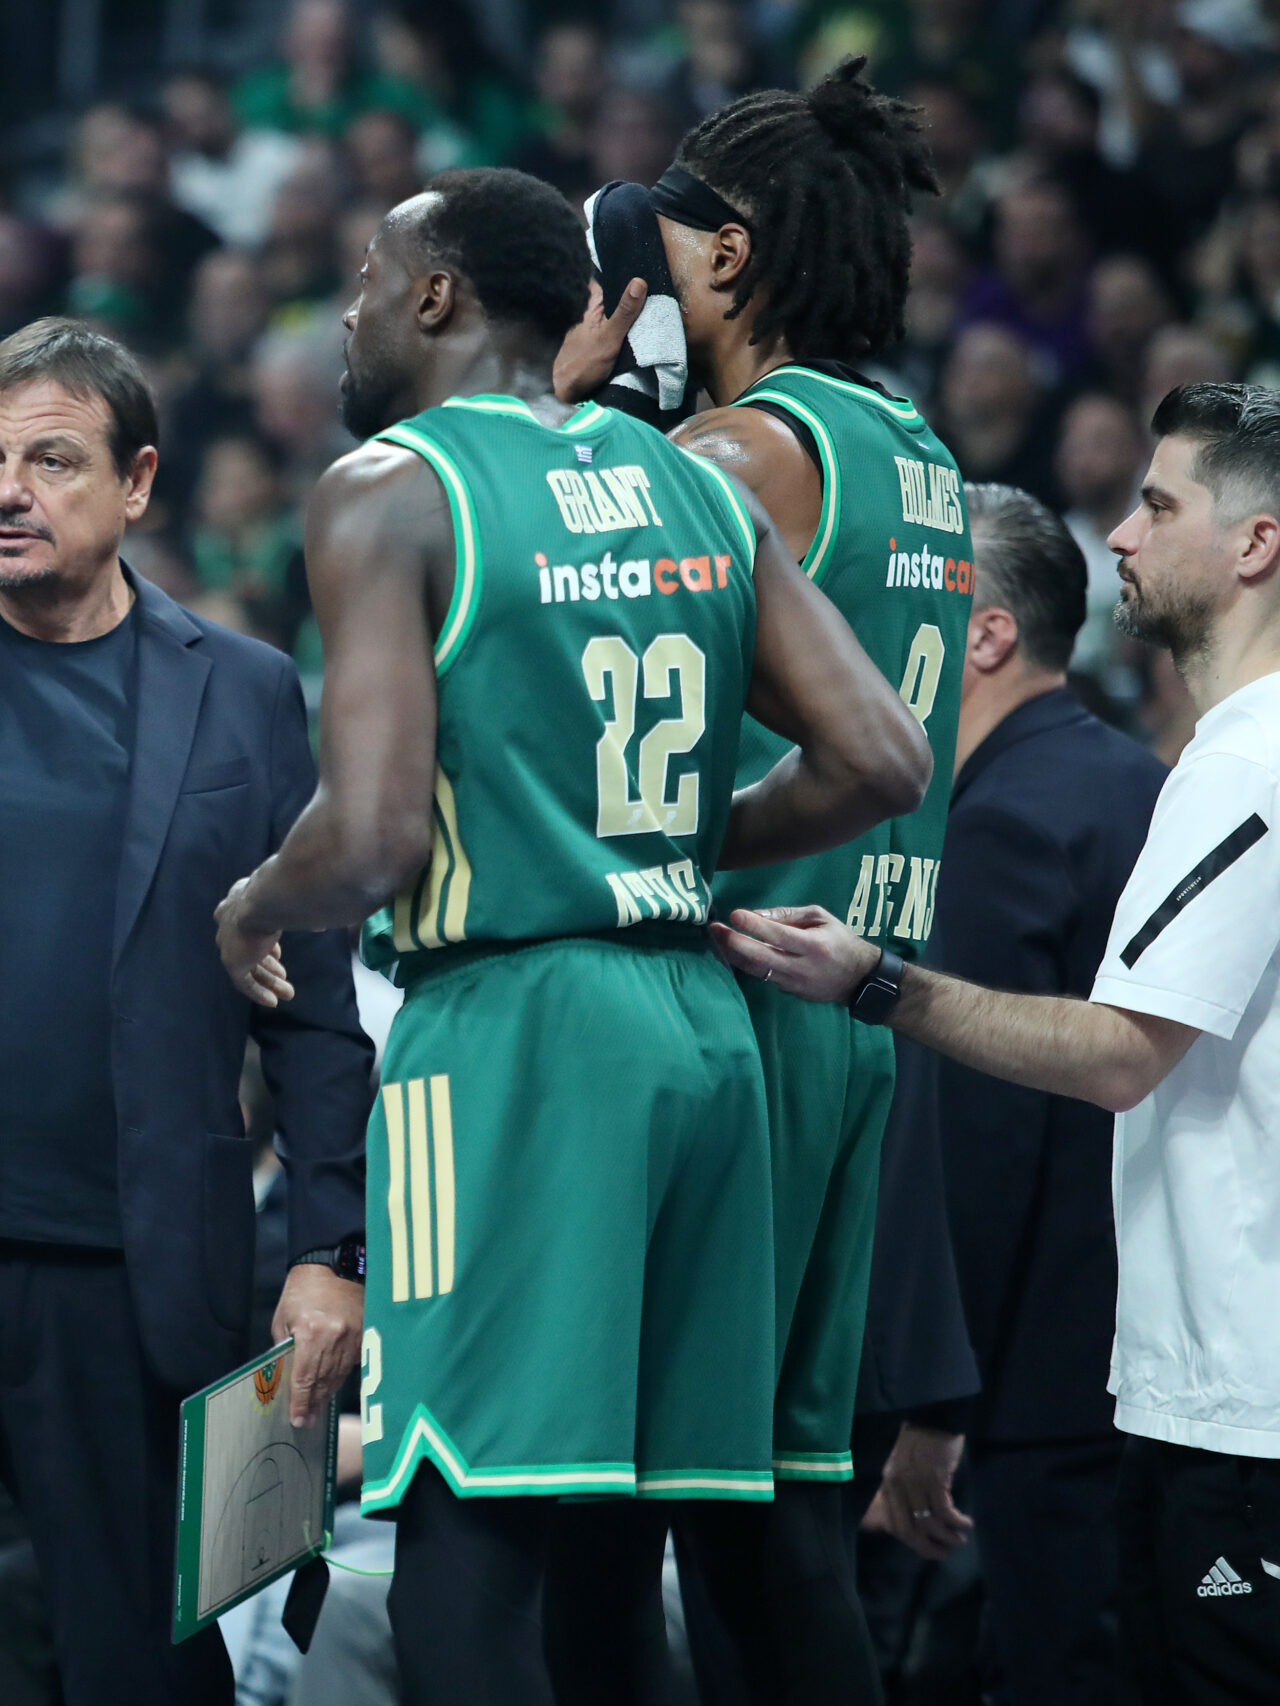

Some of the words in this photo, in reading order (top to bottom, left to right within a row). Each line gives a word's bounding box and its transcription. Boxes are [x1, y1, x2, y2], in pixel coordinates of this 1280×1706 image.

[546, 465, 663, 534] GRANT
[894, 455, 964, 535] HOLMES
[533, 552, 732, 604] instacar
[581, 633, 706, 838] 22
[1196, 1581, 1253, 1597] adidas
